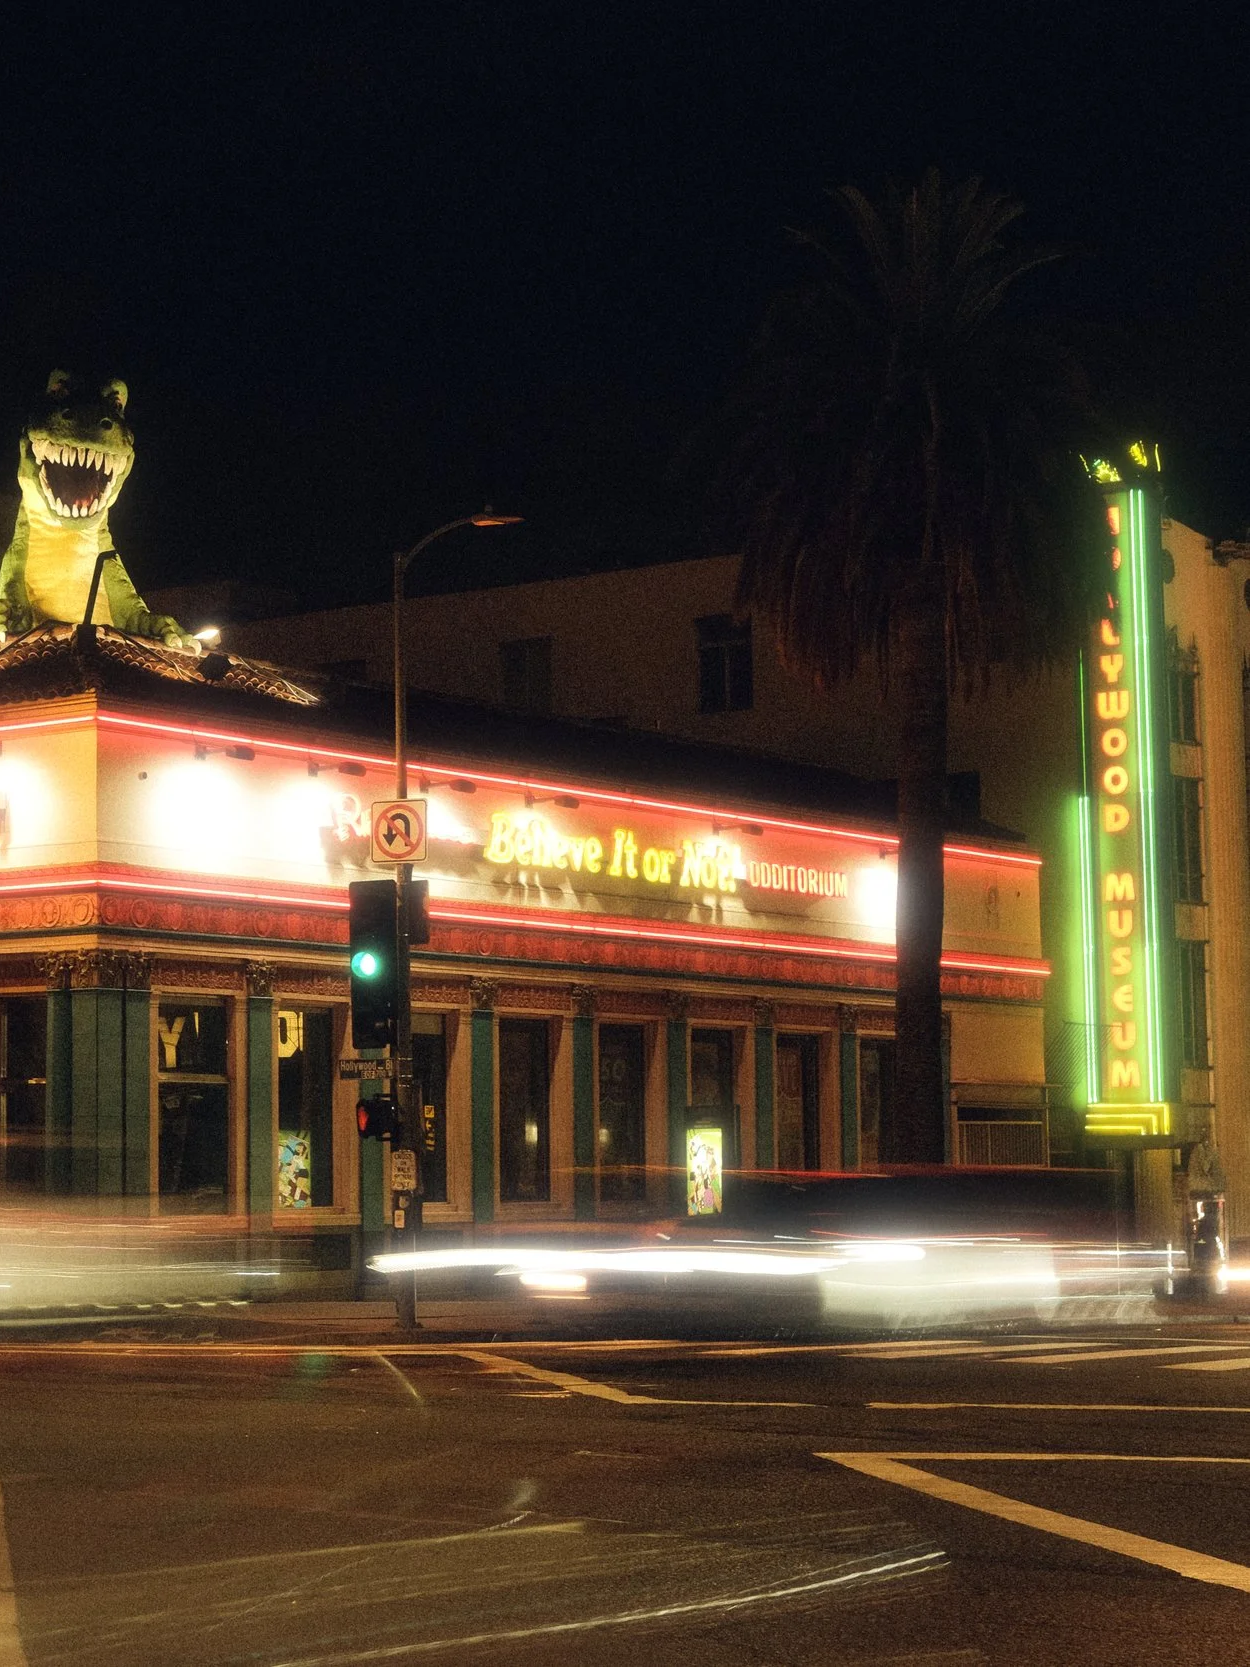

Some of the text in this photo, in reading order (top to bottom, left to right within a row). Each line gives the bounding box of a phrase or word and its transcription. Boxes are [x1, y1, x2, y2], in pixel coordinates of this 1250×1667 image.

[483, 810, 603, 874] Believe
[606, 828, 639, 879] It
[643, 847, 676, 884] or
[749, 861, 849, 899] ODDITORIUM
[1104, 872, 1141, 1088] MUSEUM
[340, 1060, 377, 1073] Hollywood
